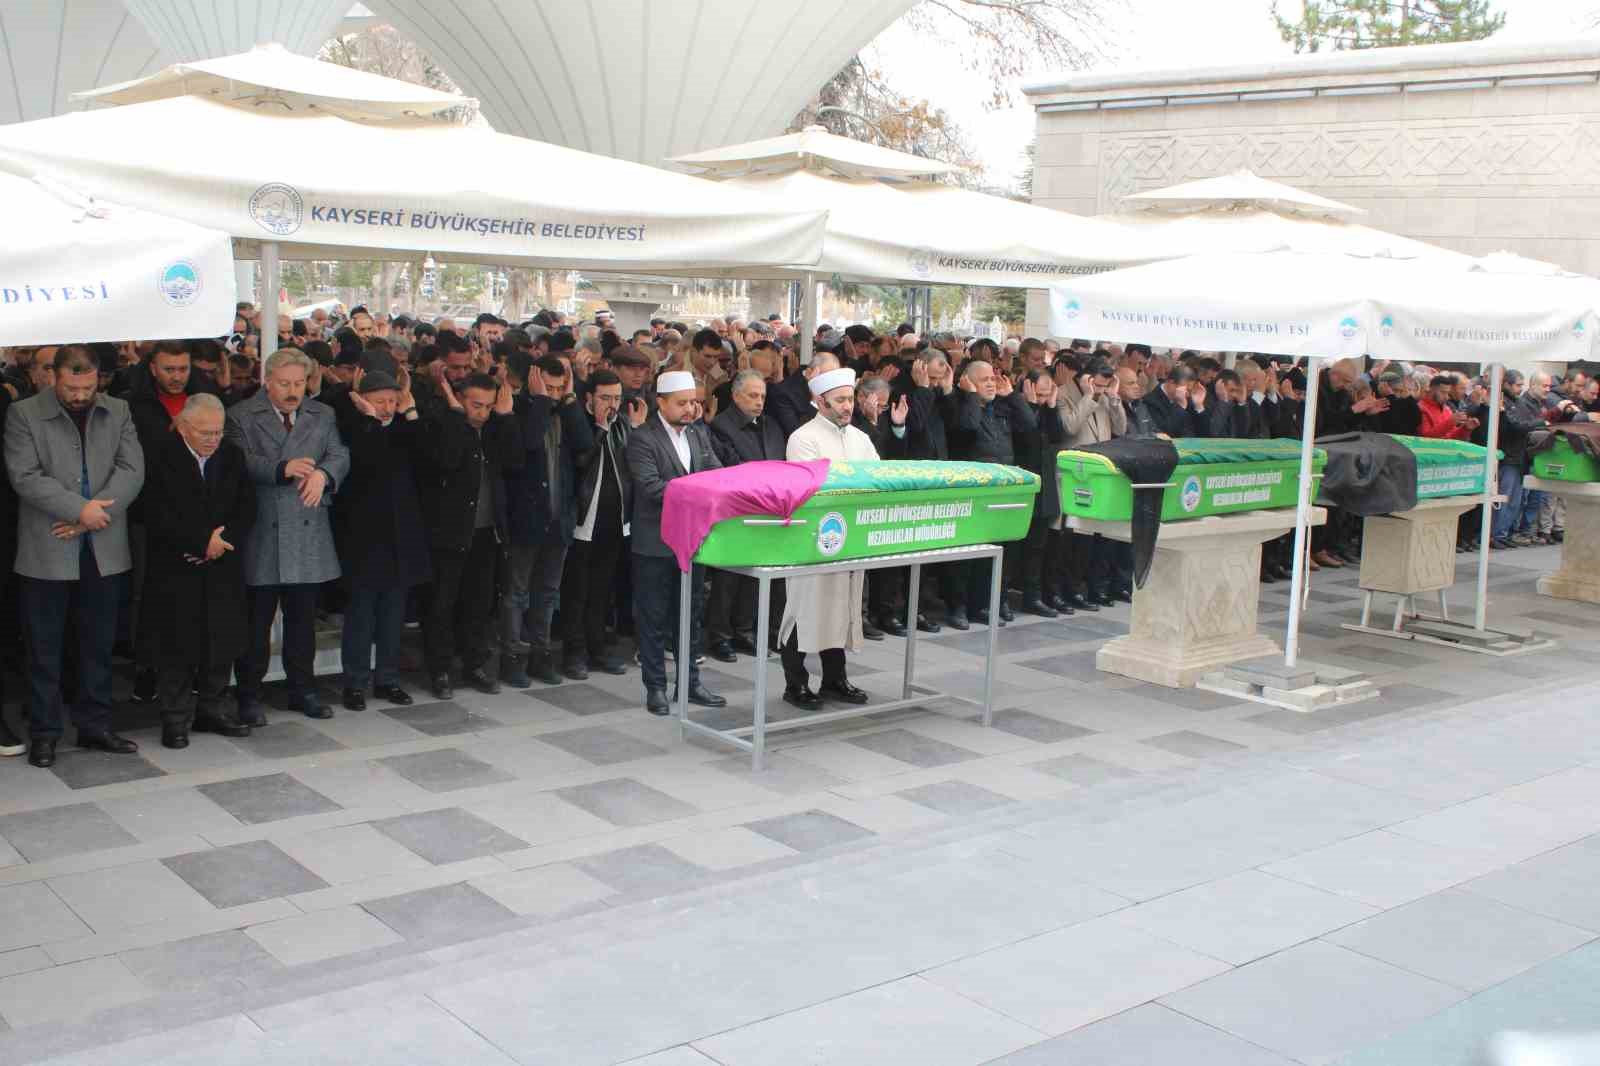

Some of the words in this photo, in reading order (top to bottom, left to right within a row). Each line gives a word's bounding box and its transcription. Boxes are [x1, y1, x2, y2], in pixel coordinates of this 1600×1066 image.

[311, 205, 405, 227] KAYSERİ
[411, 211, 535, 237] BÜYÜKŞEHİR
[541, 223, 645, 241] BELEDİYESİ
